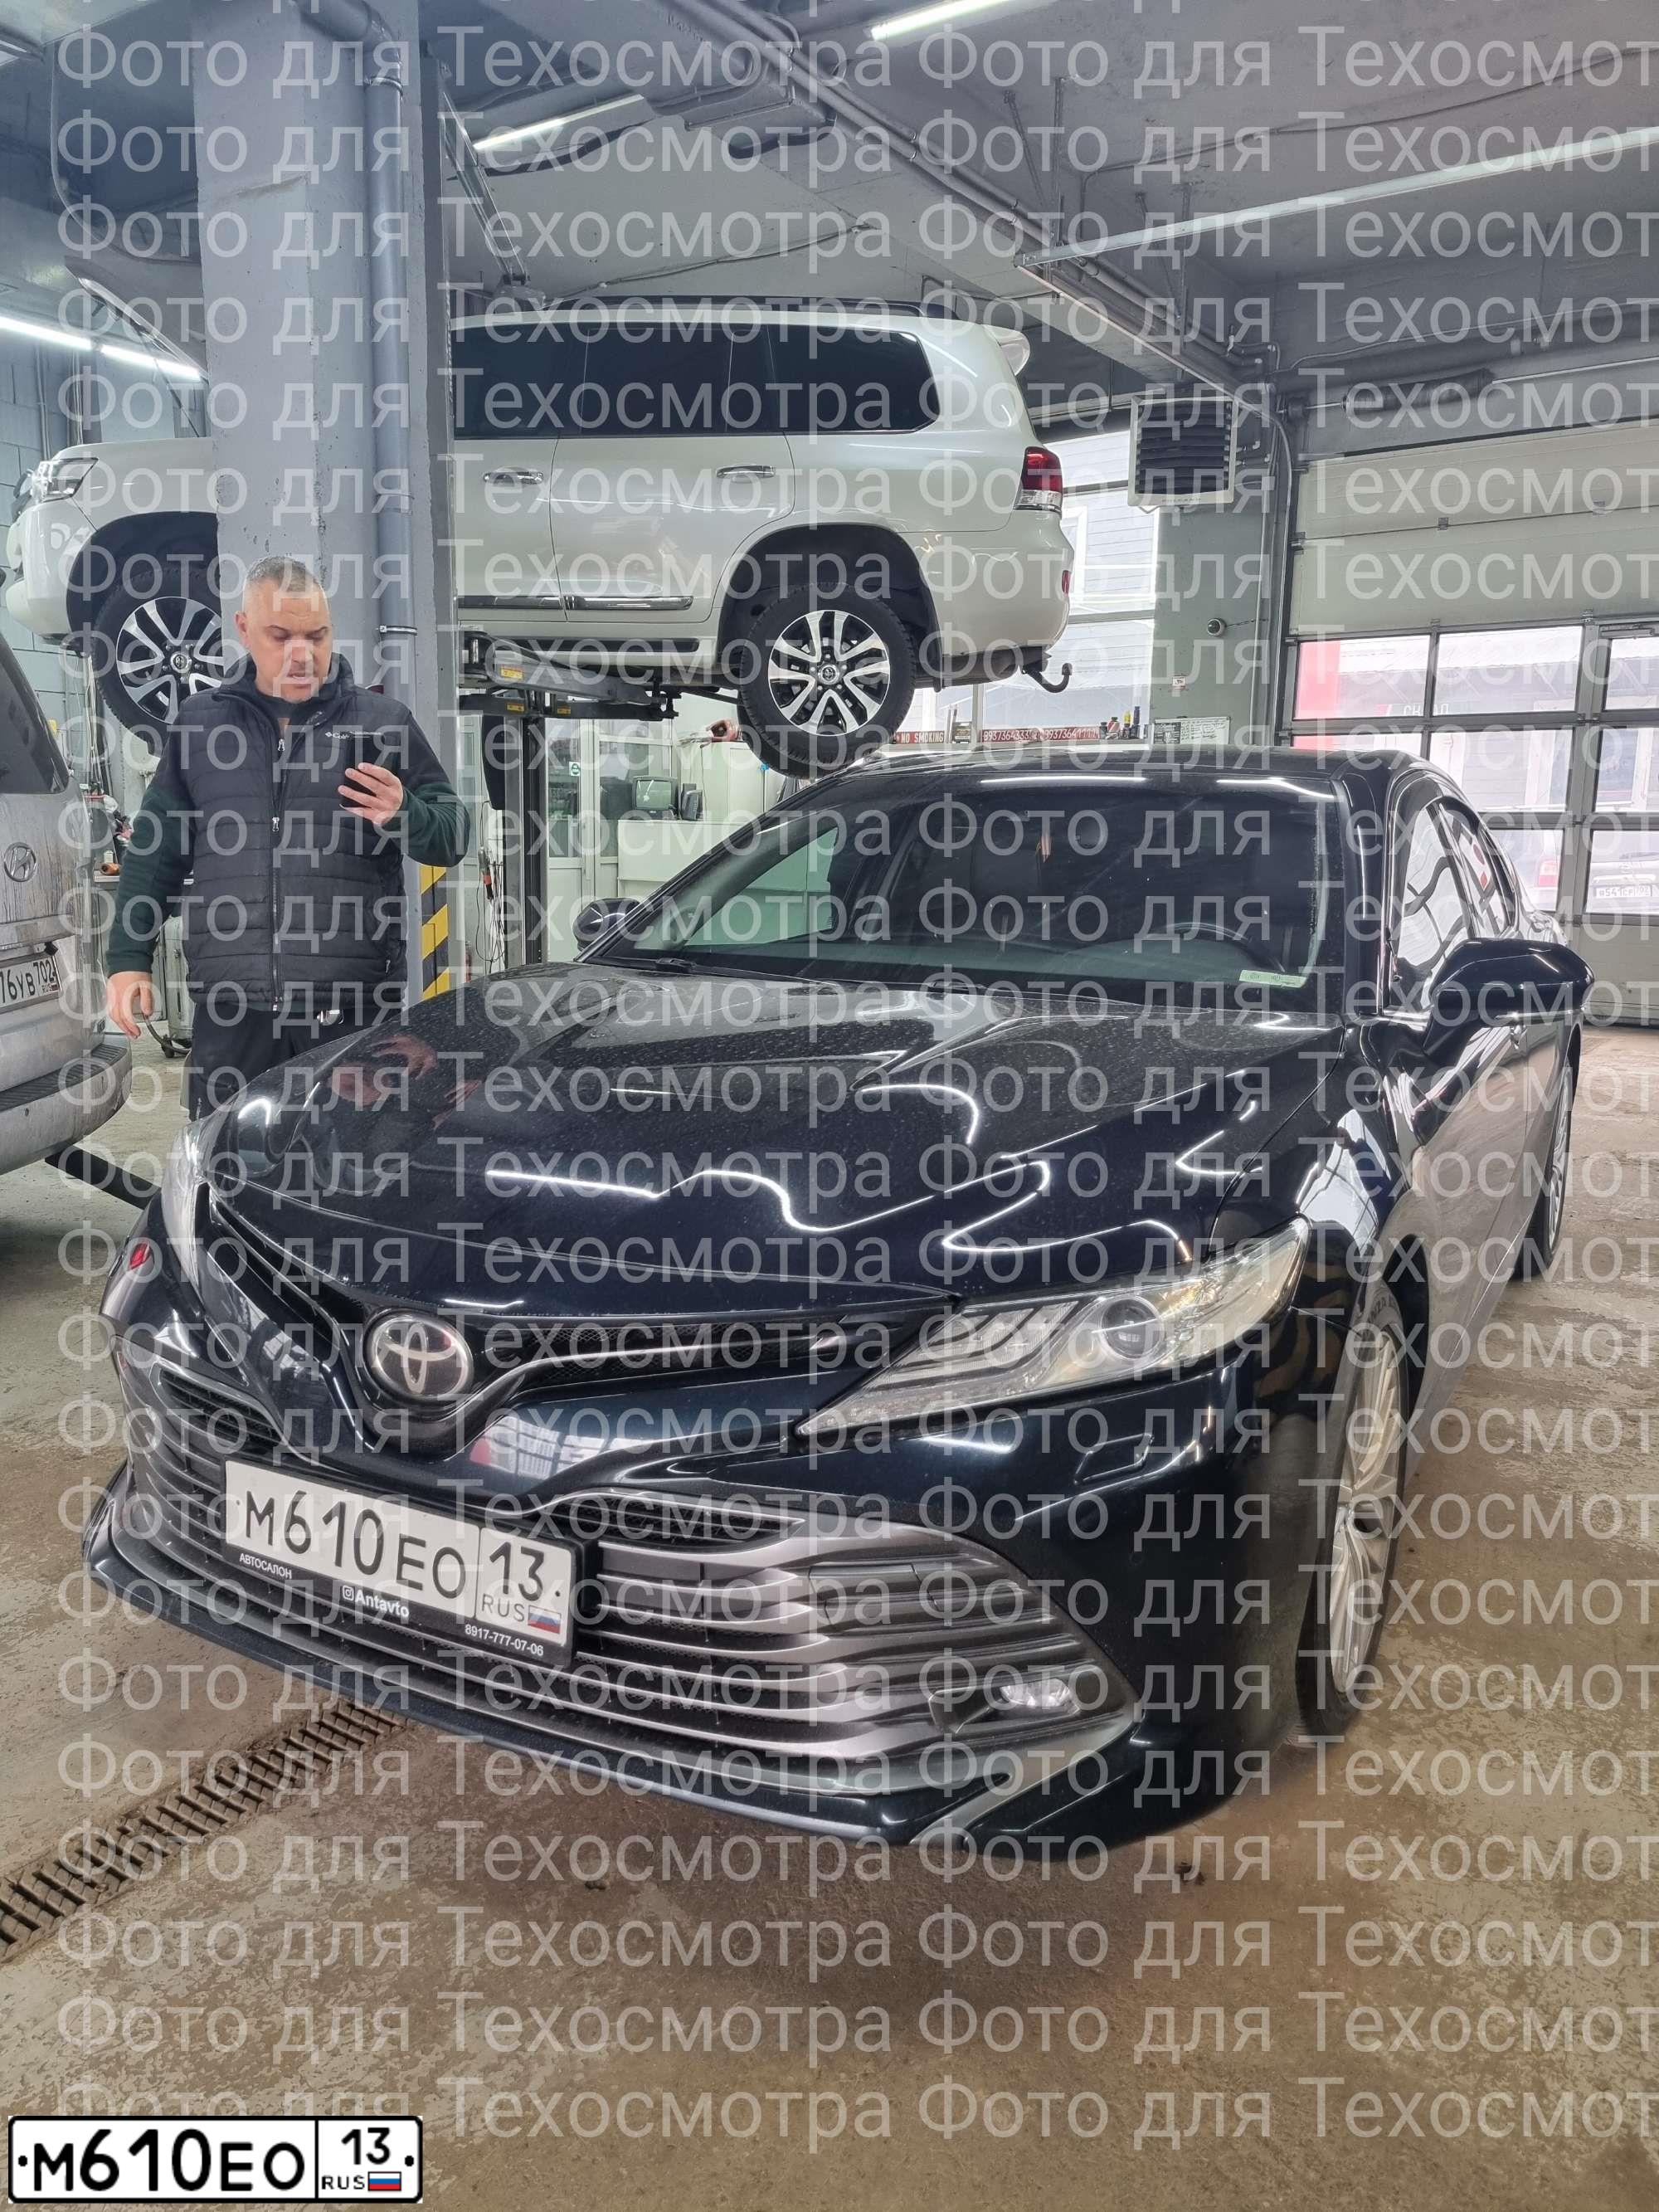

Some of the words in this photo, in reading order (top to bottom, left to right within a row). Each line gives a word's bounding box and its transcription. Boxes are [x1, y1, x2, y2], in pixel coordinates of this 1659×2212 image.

[901, 733, 910, 743] NO
[914, 732, 944, 743] SMOKING
[33, 959, 55, 985] 702
[246, 1490, 466, 1599] М610ЕО
[489, 1542, 545, 1601] 13
[239, 1552, 293, 1579] АВТОСАЛОН
[481, 1594, 525, 1622] RUS
[465, 1624, 544, 1656] 8917-777-07-06
